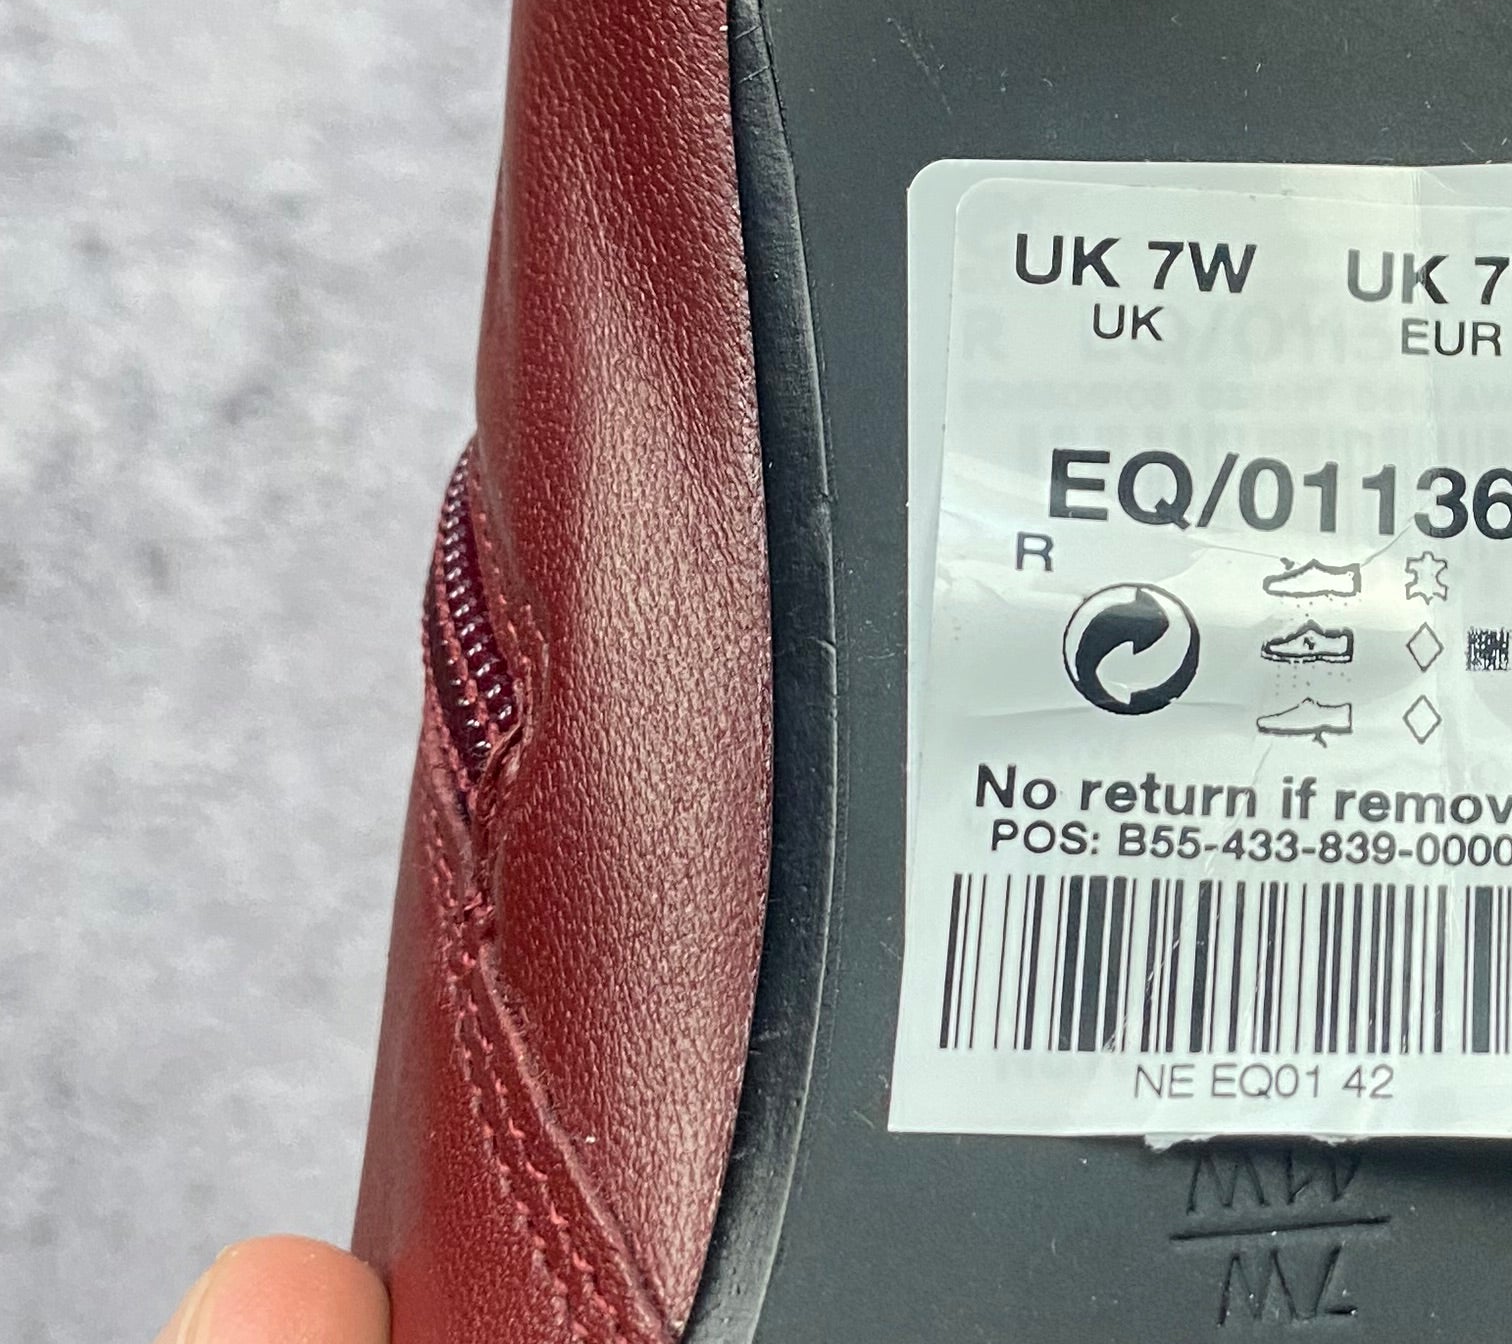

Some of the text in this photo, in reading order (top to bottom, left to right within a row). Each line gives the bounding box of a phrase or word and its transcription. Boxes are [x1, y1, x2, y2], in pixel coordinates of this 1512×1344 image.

[1015, 233, 1257, 294] UK 7W
[1347, 250, 1449, 305] UK
[1093, 303, 1164, 342] UK
[1401, 319, 1502, 357] EUR
[1016, 533, 1054, 572] R
[975, 763, 1057, 811] No
[1080, 772, 1257, 818] return
[1282, 776, 1317, 820] if
[990, 819, 1100, 855] POS:
[1134, 1063, 1395, 1099] NE EQ01 42
[1217, 1248, 1358, 1326] 7W
